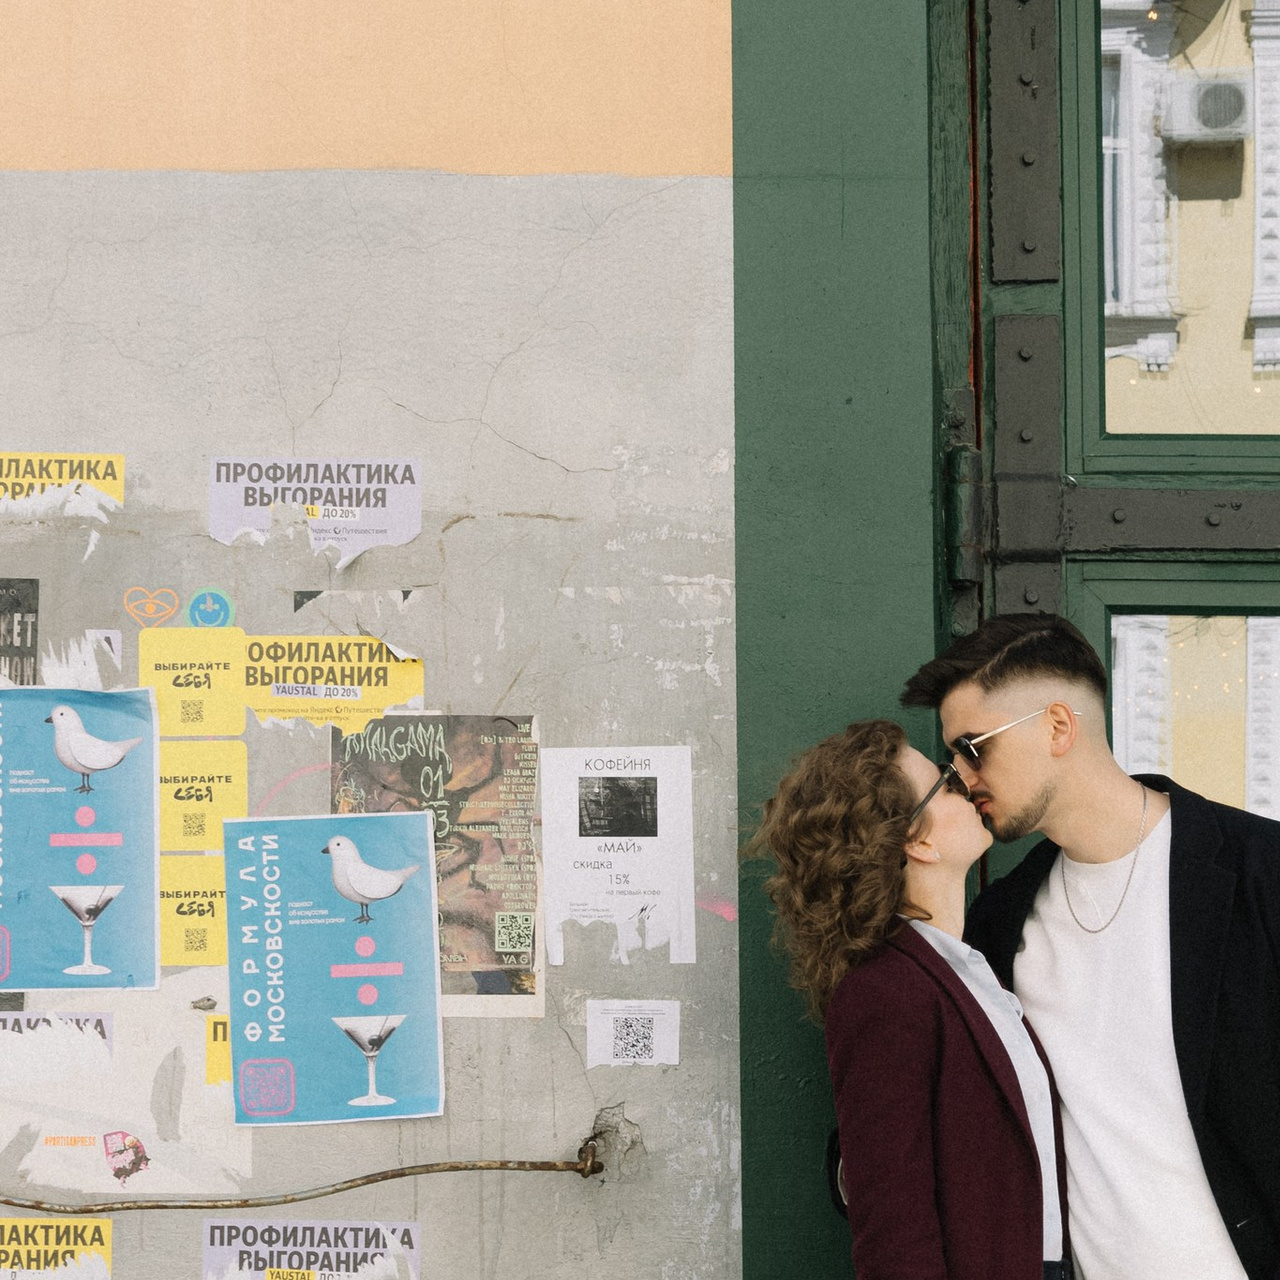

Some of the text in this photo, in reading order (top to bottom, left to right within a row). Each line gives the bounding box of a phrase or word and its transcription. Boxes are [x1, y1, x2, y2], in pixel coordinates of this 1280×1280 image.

[0, 459, 117, 480] ЛАКТИКА
[216, 462, 416, 485] ПРОФИЛАКТИКА
[244, 486, 386, 508] ВЫГОРАНИЯ
[322, 508, 337, 519] ДО
[339, 509, 356, 518] 20%
[154, 661, 231, 671] ВЫБИРАЙТЕ
[172, 673, 211, 689] СЕБЯ
[246, 666, 388, 687] ВЫГОРАНИЯ
[275, 685, 358, 697] YAUSTAL ДО 20%
[584, 756, 650, 771] КОФЕЙНЯ
[173, 785, 213, 802] СЕБЯ
[597, 839, 642, 853] «МАЙ»
[573, 860, 613, 870] скидка
[609, 874, 630, 885] 15%
[160, 889, 226, 899] ВЫБИРАЙТ
[176, 900, 215, 917] СЕБЯ
[238, 836, 263, 1042] ФОРМУЛА
[261, 834, 286, 1043] МОСКОВСКОСТИ
